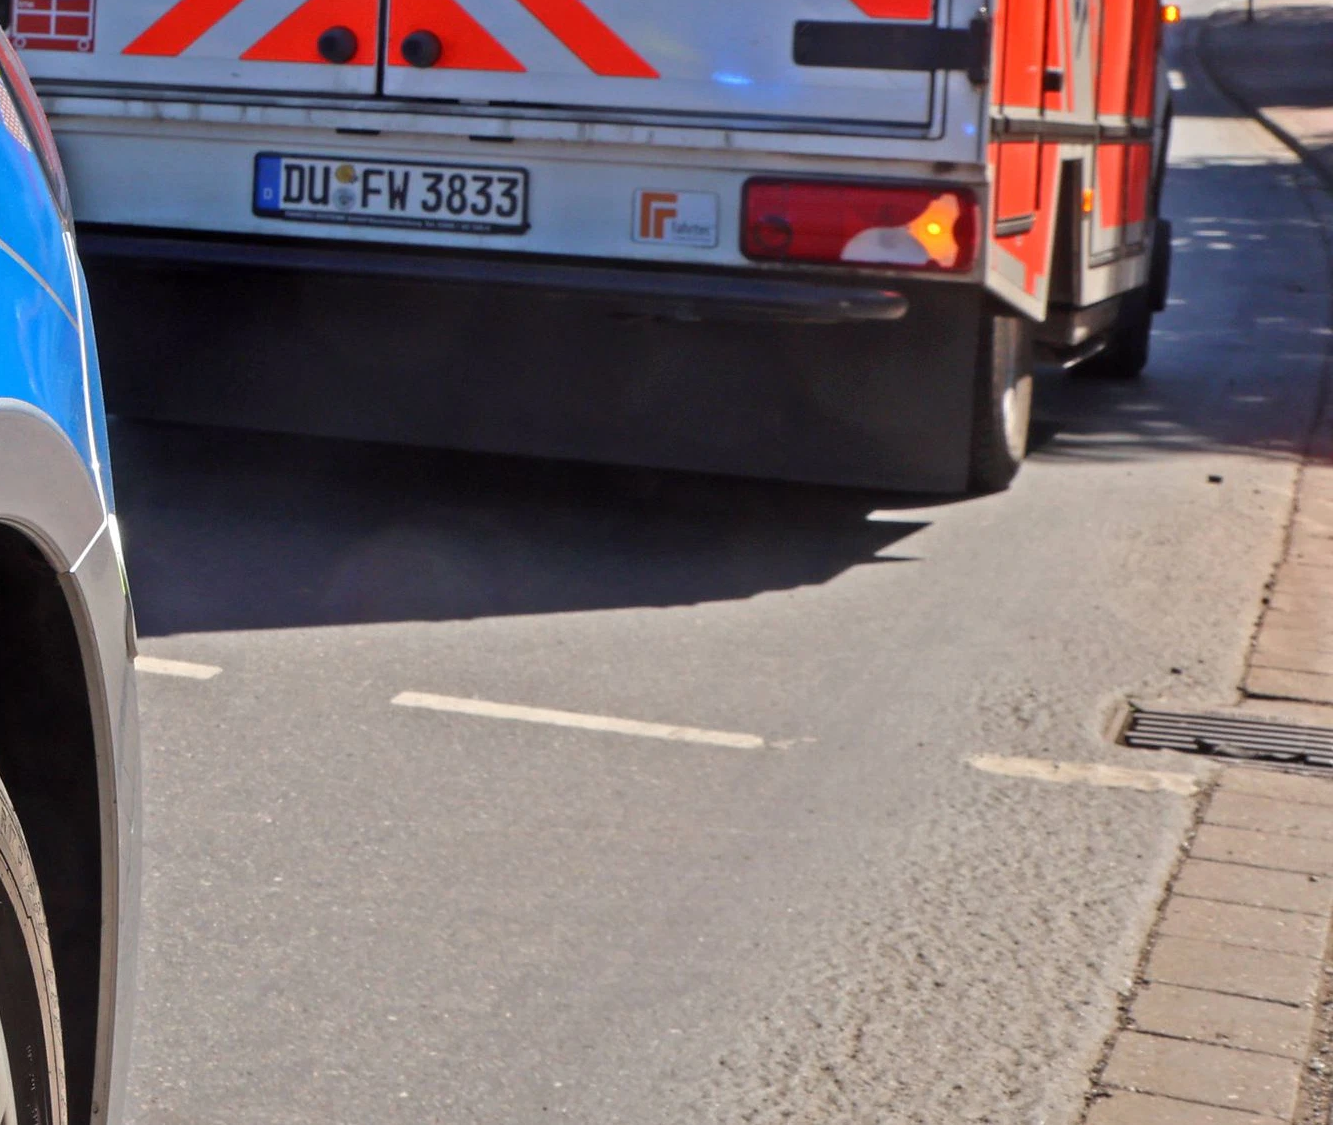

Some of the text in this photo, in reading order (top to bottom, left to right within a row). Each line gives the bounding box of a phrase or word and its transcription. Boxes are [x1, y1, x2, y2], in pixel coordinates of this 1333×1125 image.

[283, 163, 519, 218] DU FW 3833
